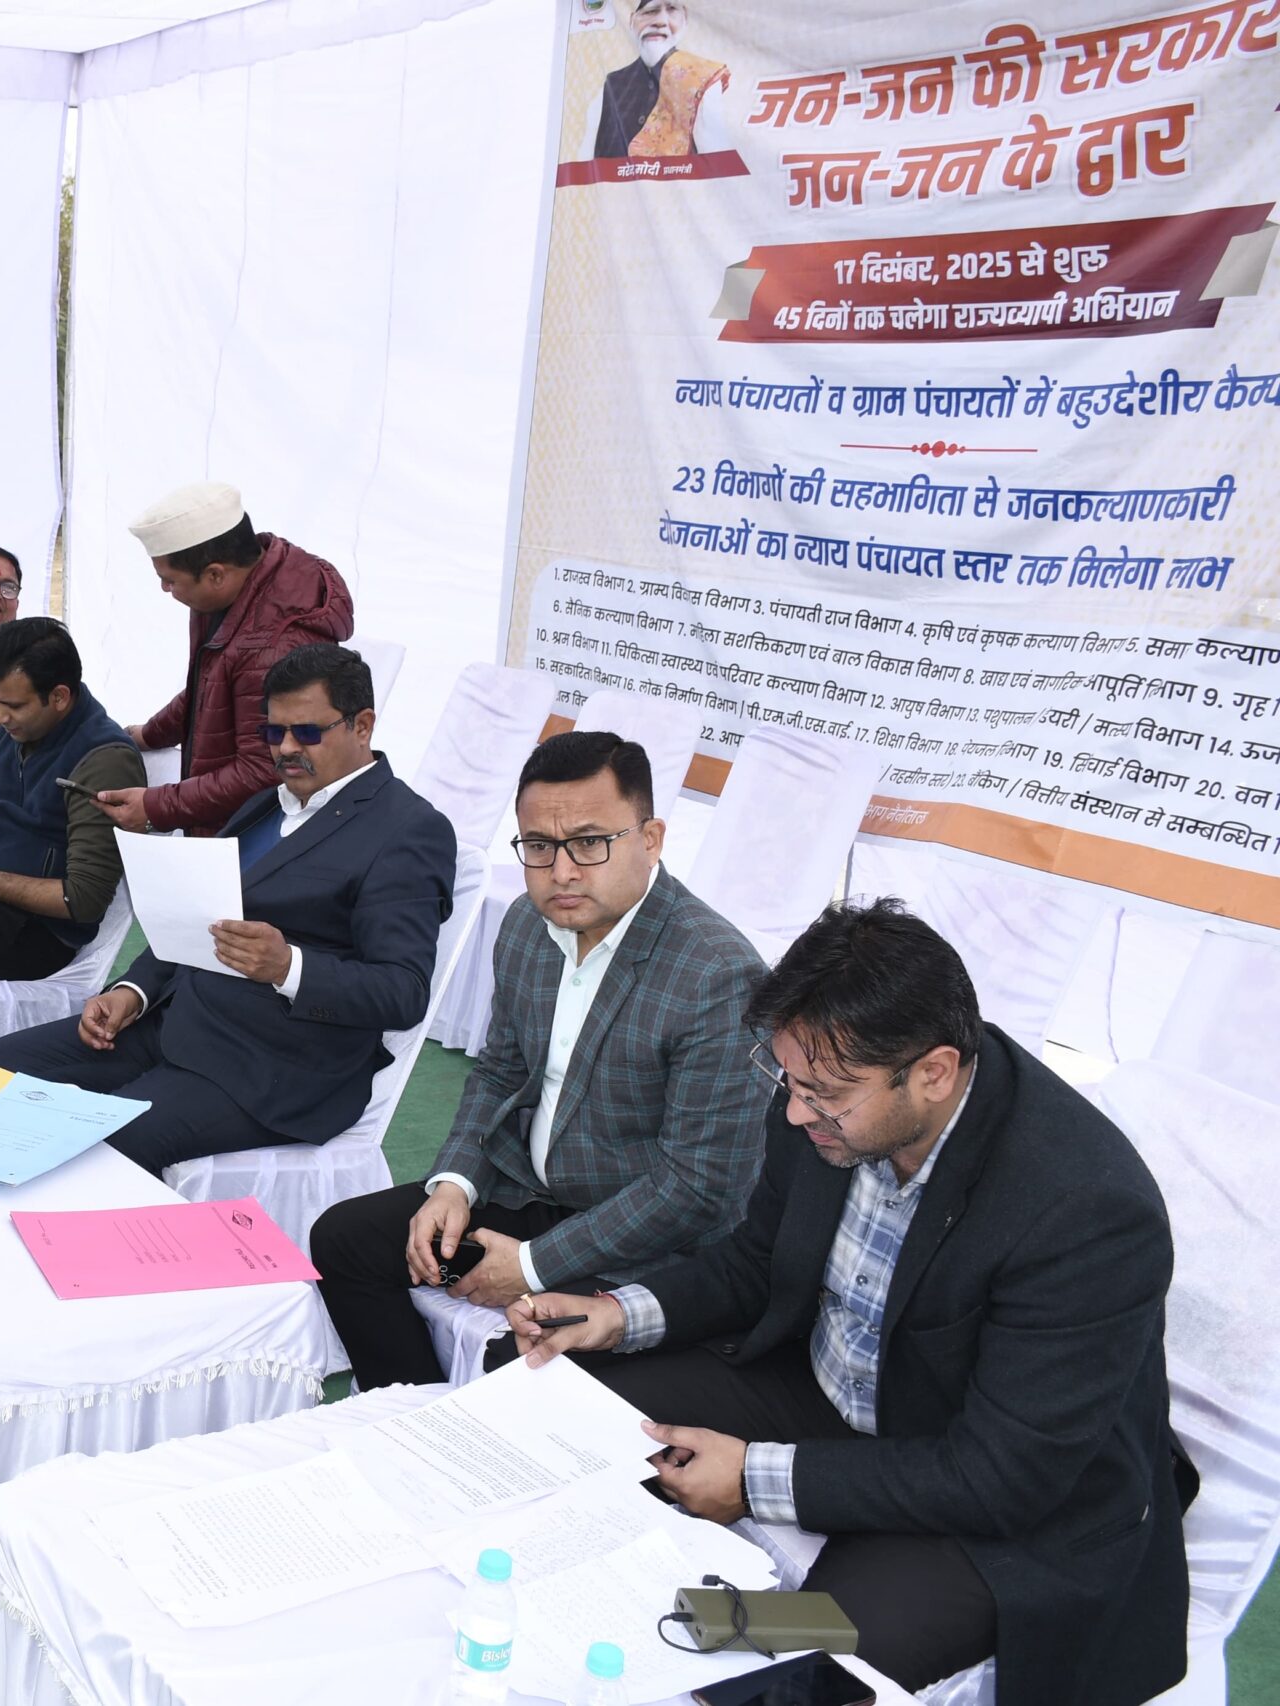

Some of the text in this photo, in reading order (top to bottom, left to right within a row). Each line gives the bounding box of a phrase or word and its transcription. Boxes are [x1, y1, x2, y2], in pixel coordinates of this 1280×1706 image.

[748, 57, 956, 127] जन-जन
[963, 24, 1047, 107] की
[782, 103, 1195, 208] जन-जन के द्वार
[834, 260, 855, 284] 17
[860, 252, 939, 285] दिसंबर,
[947, 252, 1011, 279] 2025
[1017, 242, 1046, 275] से
[774, 287, 1180, 330] 45 दिनों तक चलेगा राज्यव्यापी अभियान
[676, 379, 724, 406] न्याय
[728, 374, 824, 412] पंचायतों
[828, 385, 848, 415] व
[852, 385, 908, 416] ग्राम
[912, 374, 1022, 418] पंचायतों
[1024, 374, 1056, 416] में
[1056, 368, 1212, 430] बहुउद्देशीय
[674, 459, 1236, 522] 23 विभागों की सहभागिता से जनकल्याणकारी
[757, 530, 790, 560] का
[794, 533, 850, 568] न्याय
[857, 538, 946, 578] पंचायत
[954, 549, 1012, 584] स्तर
[1016, 554, 1068, 585] तक
[1068, 544, 1164, 590] मिलेगा
[1167, 556, 1232, 589] लाभ
[555, 568, 560, 580] 1.
[563, 569, 592, 586] राजस्व
[593, 570, 625, 591] विभाग
[627, 579, 636, 593] 2.
[640, 581, 670, 598] ग्राम्य
[705, 588, 752, 613] विभाग
[753, 600, 765, 615] 3.
[770, 598, 823, 623] पंचायती
[825, 610, 853, 628] राज
[855, 609, 903, 635] विभाग
[904, 622, 917, 637] 4.
[922, 620, 955, 645] कृषि
[957, 624, 979, 644] एवं
[980, 629, 1023, 652] कृषक
[1023, 633, 1080, 652] कल्याण
[1079, 631, 1129, 654] विभाग
[1125, 637, 1140, 653] 5.
[1145, 637, 1194, 659] समा
[537, 628, 549, 642] 10.
[552, 631, 570, 646] श्रम
[572, 631, 600, 653] विभाग
[601, 641, 611, 656] 11.
[614, 640, 660, 665] चिकित्सा
[661, 653, 704, 674] स्वास्थ्य
[705, 660, 718, 678] एवं
[719, 663, 764, 687] परिवार
[766, 674, 821, 698] कल्याण
[822, 680, 868, 707] विभाग
[870, 694, 885, 709] 12.
[890, 697, 927, 719] आयुष
[925, 698, 967, 720] विभाग
[965, 708, 979, 722] 13.
[1133, 717, 1205, 750] विभाग
[1209, 736, 1233, 756] 14.
[553, 600, 562, 613] 6.
[565, 597, 593, 618] सैनिक
[594, 607, 635, 627] कल्याण
[636, 610, 674, 634] विभाग
[678, 622, 686, 636] 7.
[723, 631, 807, 658] सशक्तिकरण
[809, 643, 831, 662] एवं
[832, 649, 864, 666] बाल
[865, 650, 915, 676] विकास
[915, 657, 962, 682] विभाग
[963, 669, 974, 684] 8.
[980, 670, 1011, 687] खाद्य
[1010, 669, 1033, 689] एवं
[1032, 671, 1088, 691] नागरिक
[1202, 688, 1223, 708] 9.
[1233, 692, 1272, 721] गृह
[536, 657, 548, 671] 15.
[550, 660, 593, 680] सहकारिता
[593, 666, 622, 688] विभाग
[623, 677, 635, 692] 16.
[639, 678, 663, 696] लोक
[665, 682, 704, 706] निर्माण
[705, 691, 738, 715] विभाग
[855, 727, 869, 743] 17.
[873, 726, 906, 749] शिक्षा
[905, 732, 944, 754] विभाग
[1043, 750, 1063, 769] 19.
[1119, 759, 1190, 792] विभाग
[1194, 780, 1225, 800] 20.
[1235, 785, 1273, 808] वन
[889, 767, 931, 784] तहसील
[1019, 780, 1071, 806] वित्तीय
[1070, 790, 1144, 823] संस्थान
[1144, 807, 1166, 827] से
[1166, 814, 1272, 852] सम्बन्धित
